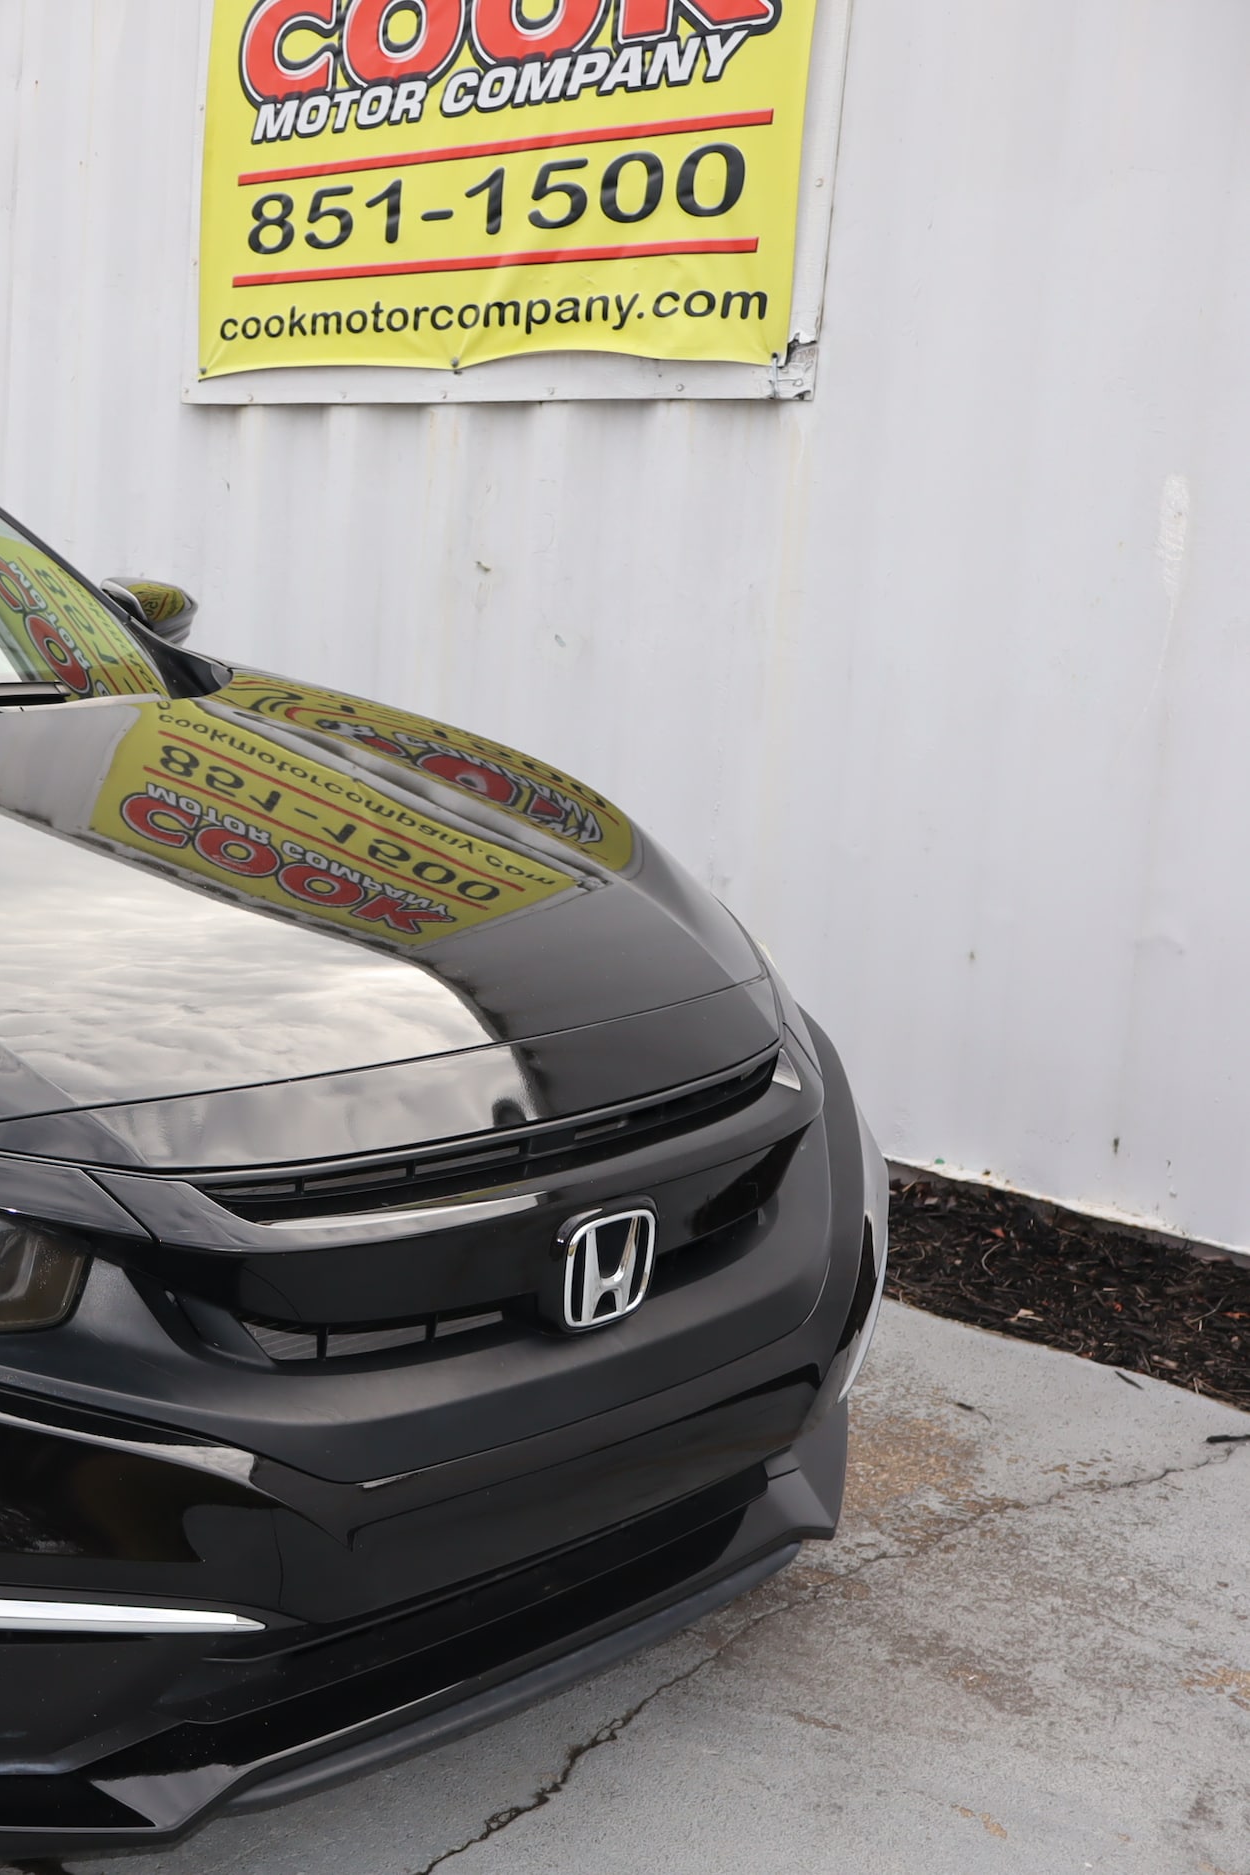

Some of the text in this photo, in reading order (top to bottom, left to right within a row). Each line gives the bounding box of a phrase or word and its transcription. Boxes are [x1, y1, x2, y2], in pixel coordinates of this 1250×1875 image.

[251, 28, 751, 144] MOTOR COMPANY
[247, 142, 746, 255] 851-1500
[218, 288, 768, 342] cookmotorcompany.com
